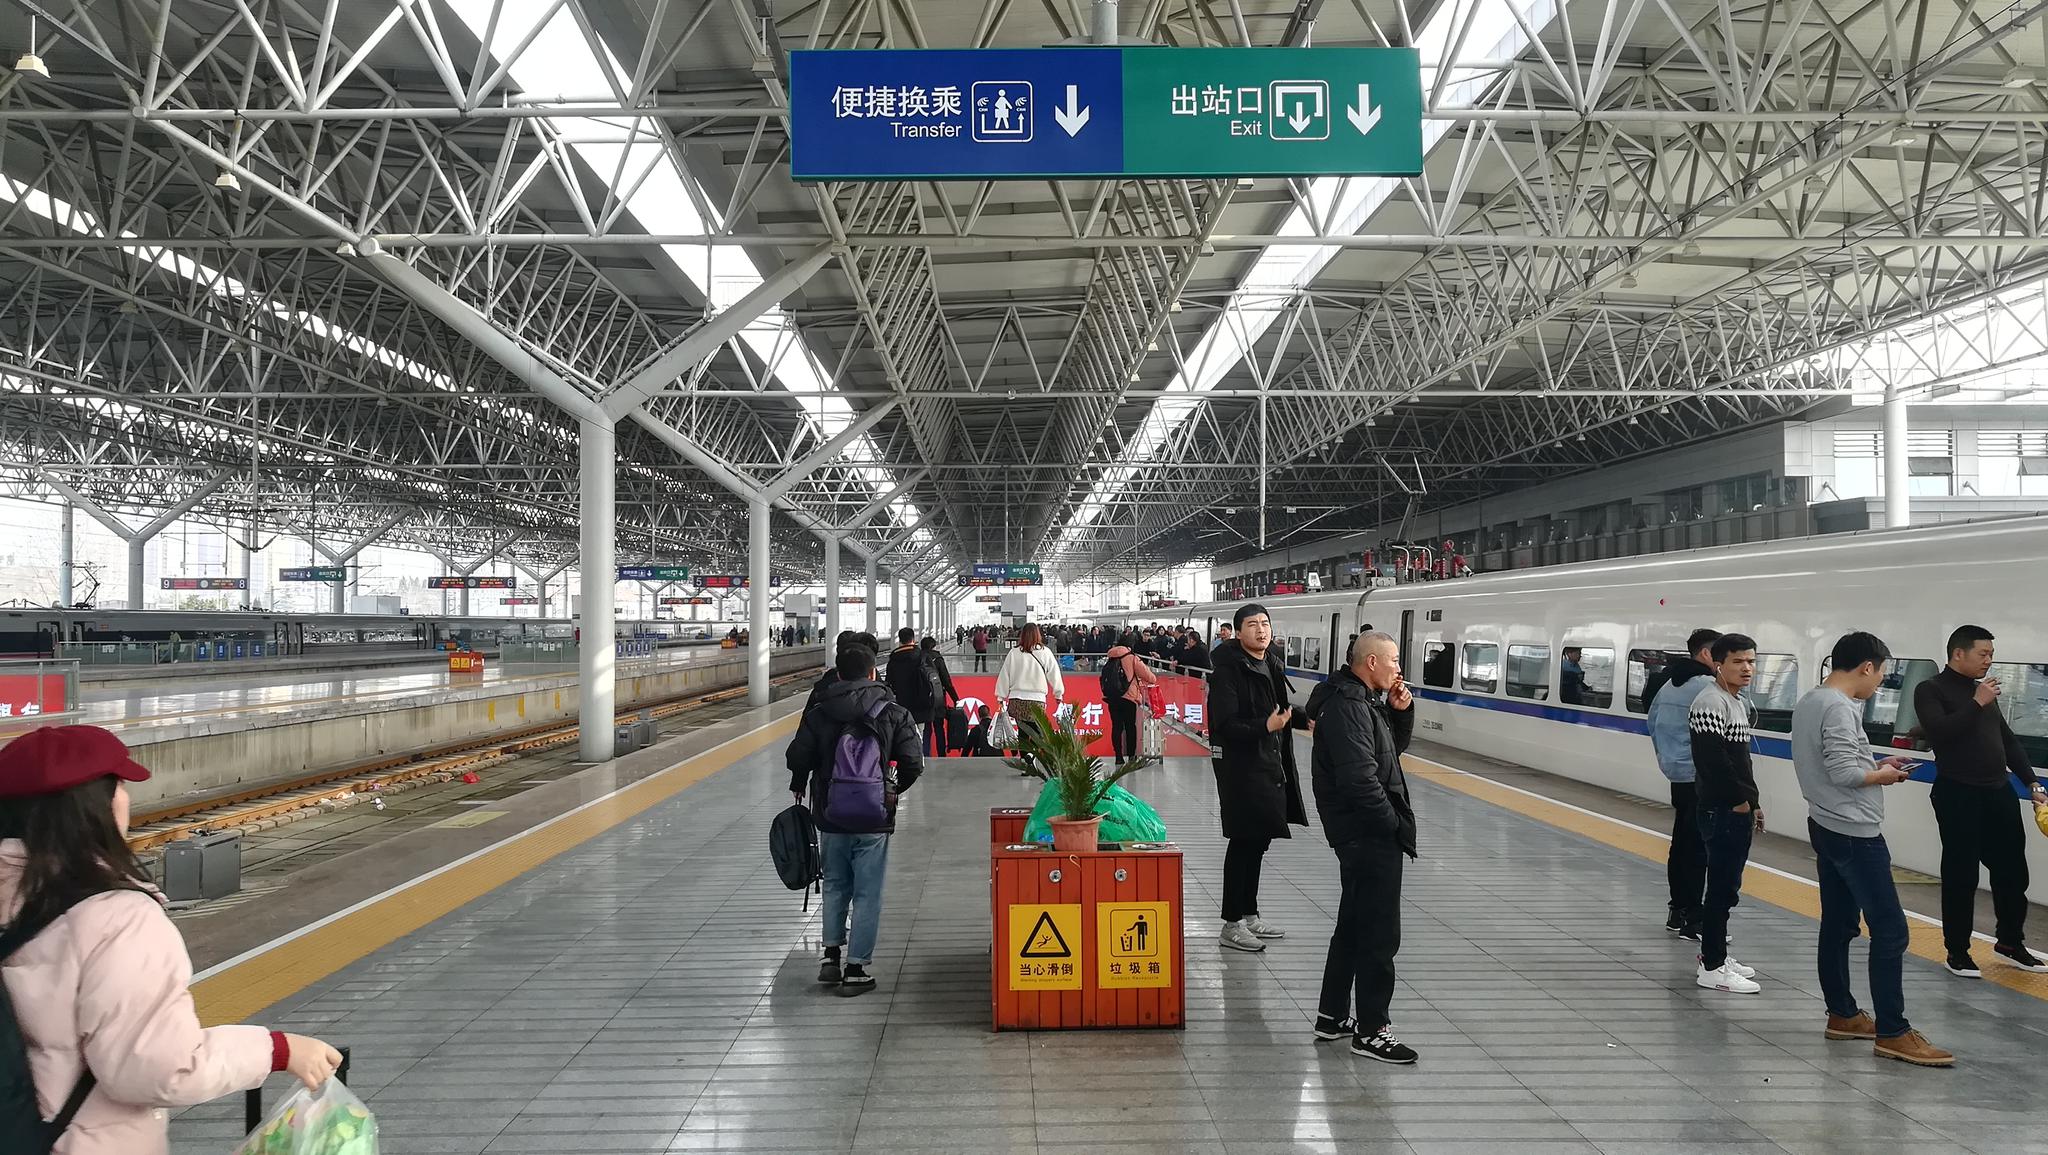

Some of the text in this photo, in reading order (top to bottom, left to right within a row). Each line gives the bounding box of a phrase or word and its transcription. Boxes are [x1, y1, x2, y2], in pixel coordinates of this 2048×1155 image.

[832, 85, 962, 118] 便捷换乘
[1171, 83, 1262, 116] 出站口
[890, 121, 963, 138] Transfer
[1230, 119, 1263, 136] Exit
[163, 579, 170, 589] 9
[239, 579, 246, 589] 8
[430, 578, 437, 587] 7
[507, 578, 514, 588] 6
[695, 576, 702, 587] 5
[771, 576, 779, 586] 4
[960, 576, 967, 586] 3
[1034, 576, 1041, 585] 2
[1020, 963, 1073, 976] 当心滑倒
[1110, 961, 1160, 975] 垃圾箱
